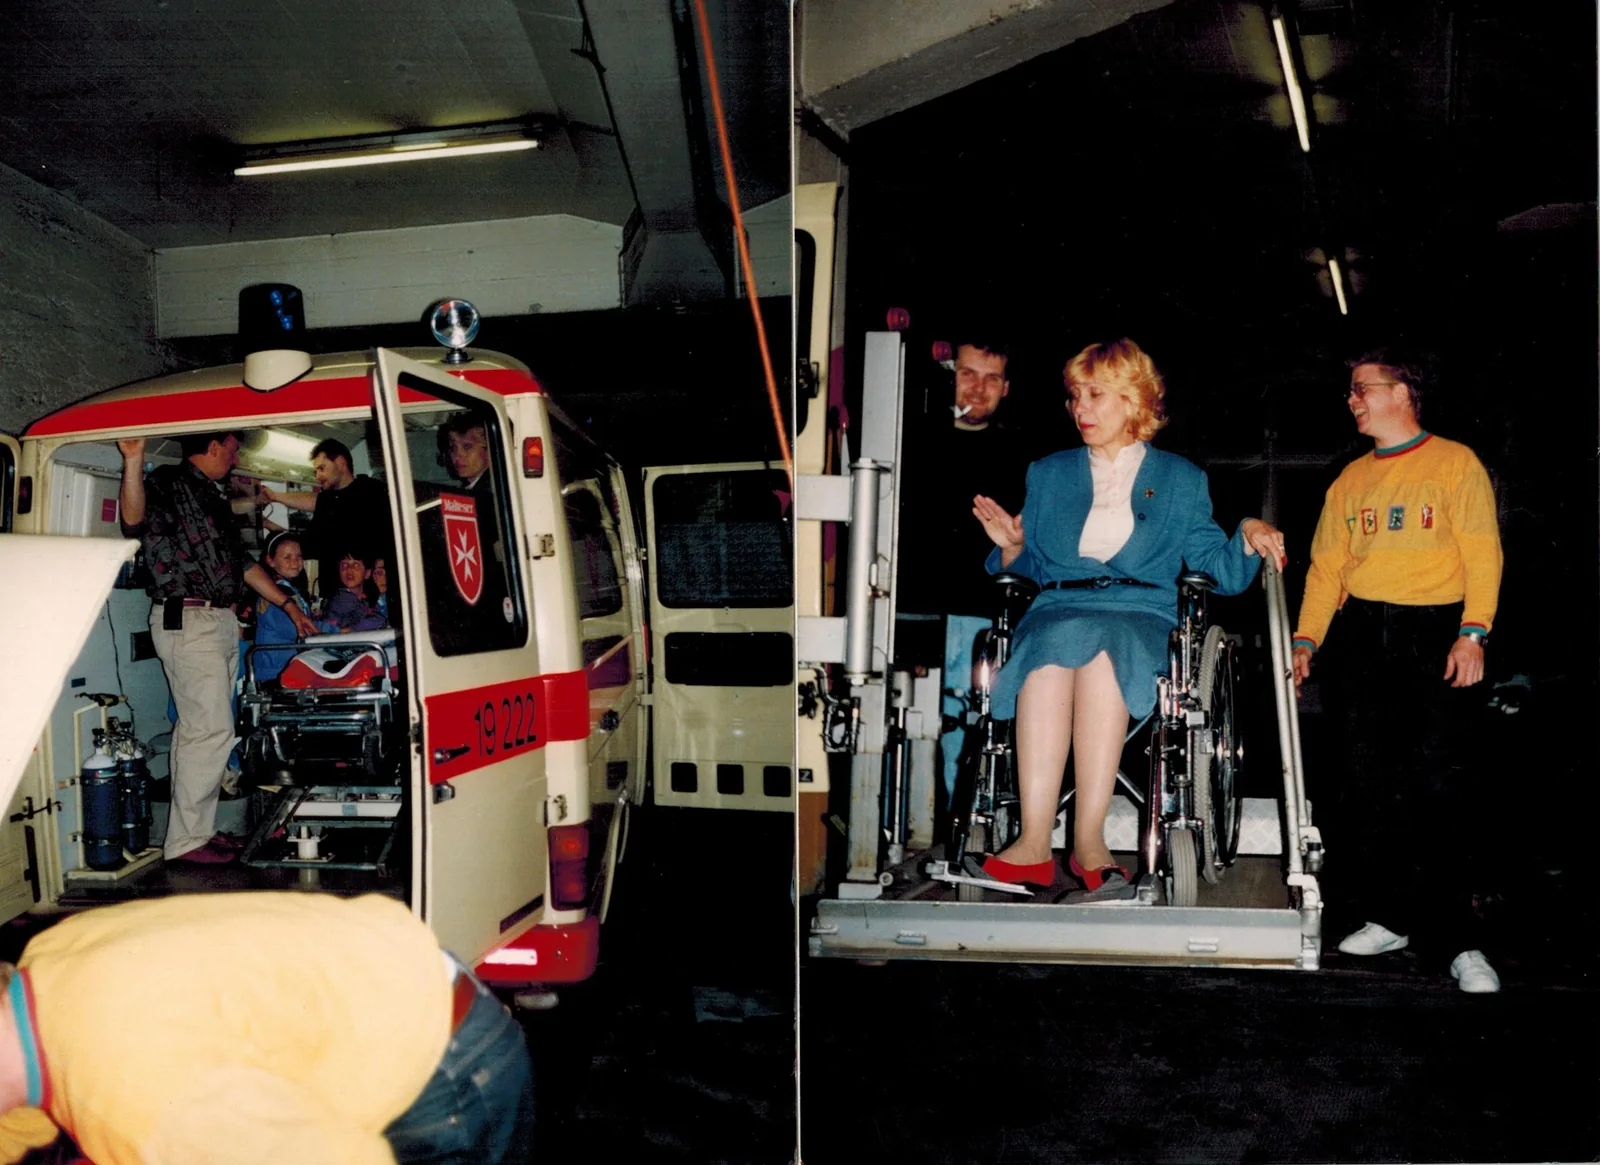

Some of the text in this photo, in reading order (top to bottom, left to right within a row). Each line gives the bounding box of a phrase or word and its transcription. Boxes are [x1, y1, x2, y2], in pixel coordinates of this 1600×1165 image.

[443, 499, 474, 514] Malteser
[474, 692, 537, 759] 19 222
